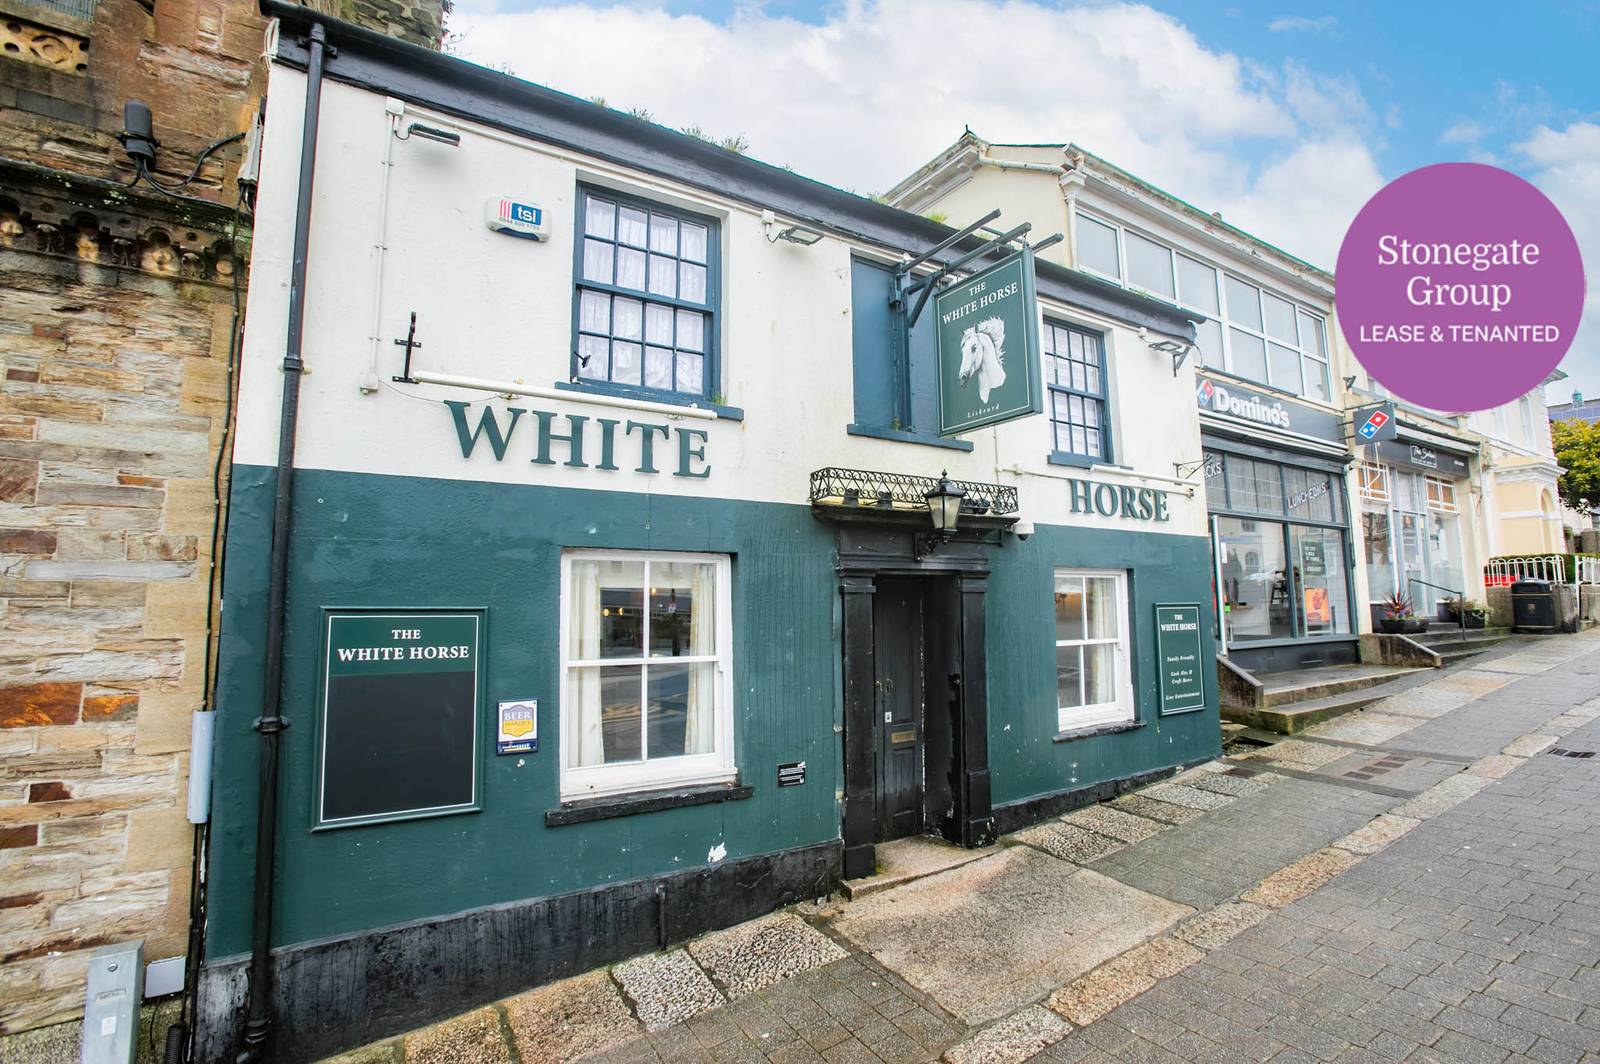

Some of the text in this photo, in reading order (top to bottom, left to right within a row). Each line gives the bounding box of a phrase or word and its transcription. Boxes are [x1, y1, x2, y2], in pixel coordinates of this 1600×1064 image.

[517, 206, 536, 222] tsi
[969, 282, 987, 297] THE
[942, 282, 1018, 325] WHITE HORSE
[967, 402, 1000, 418] Liskeard
[444, 400, 711, 478] WHITE
[1067, 479, 1170, 522] HORSE
[1287, 482, 1327, 509] LUNCHEONS
[392, 629, 421, 640] THE
[1160, 622, 1197, 631] WHITE HORSE
[338, 646, 470, 662] WHITE HORSE
[503, 711, 531, 721] BEER
